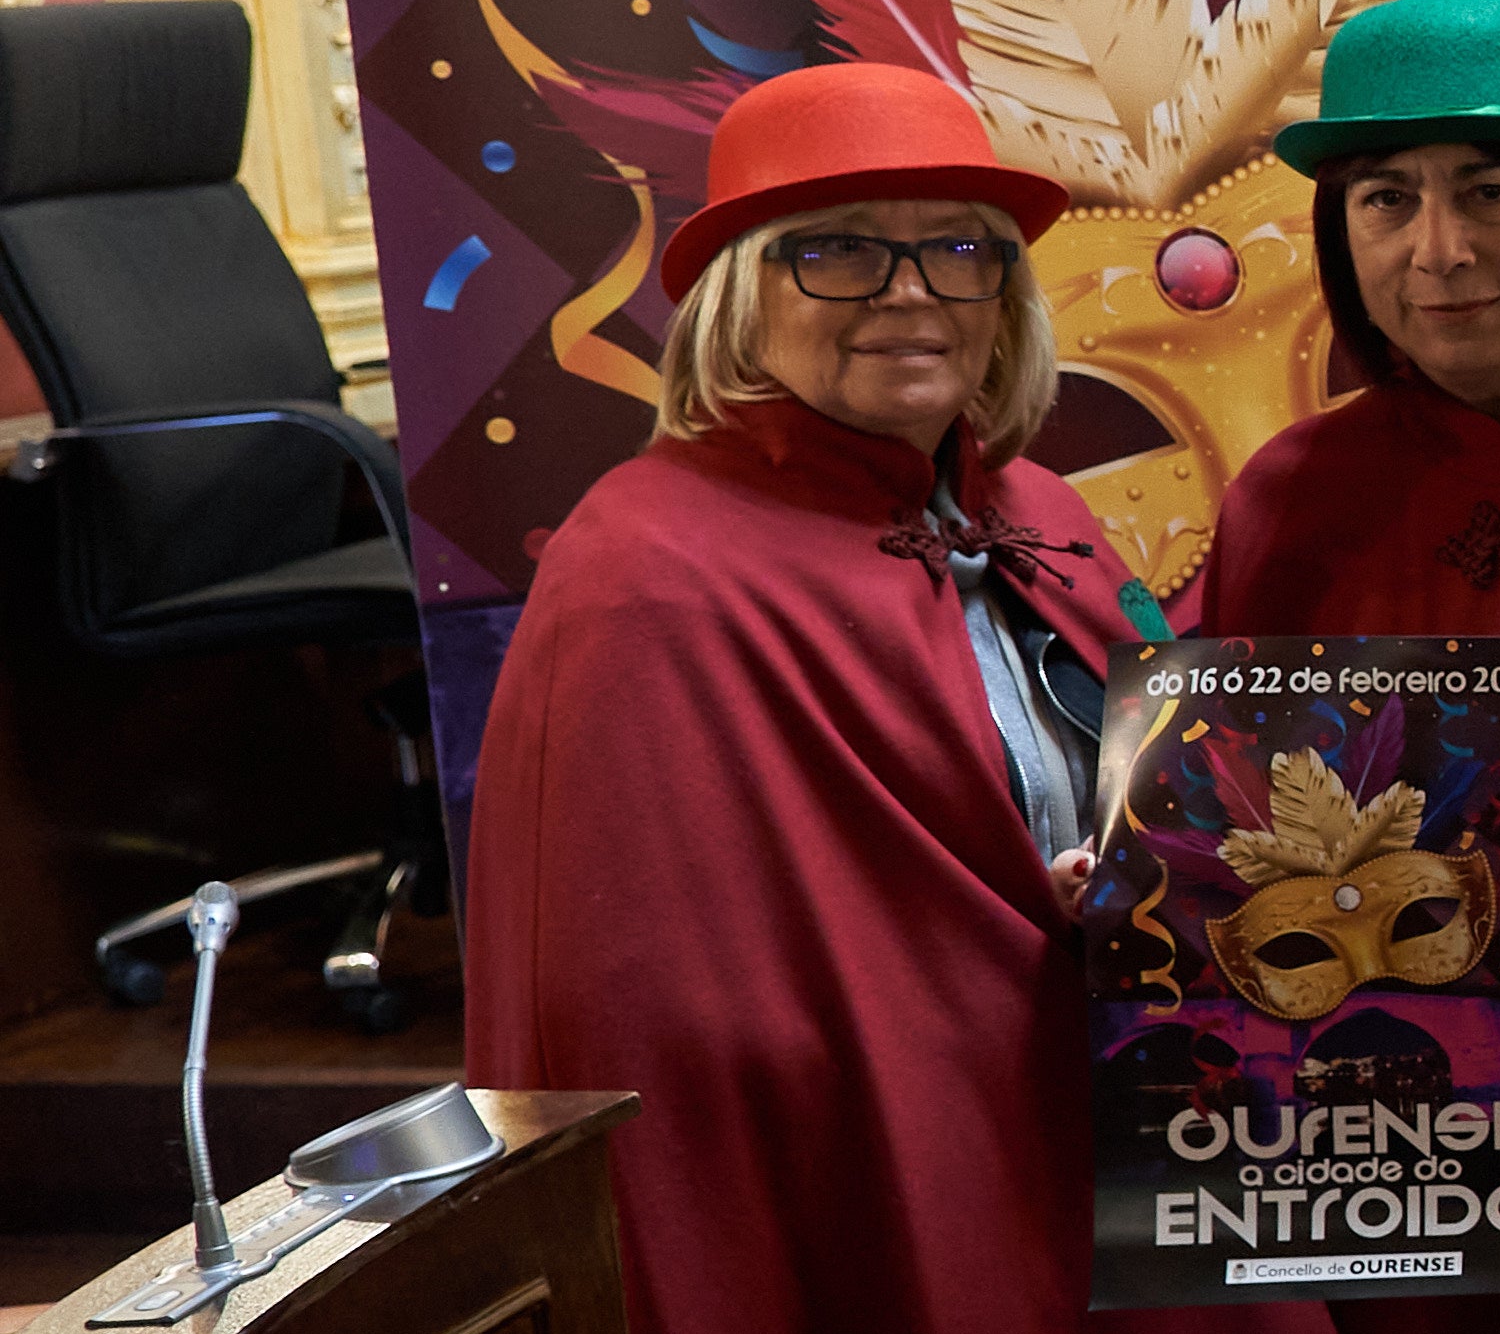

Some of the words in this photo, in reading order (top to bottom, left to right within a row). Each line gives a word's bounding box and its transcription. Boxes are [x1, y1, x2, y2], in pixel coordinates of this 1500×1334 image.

[1147, 669, 1183, 696] do
[1189, 668, 1217, 695] 16
[1248, 667, 1283, 694] 22
[1289, 667, 1332, 694] de
[1339, 666, 1467, 694] febreiro
[1239, 1165, 1263, 1186] a
[1273, 1157, 1404, 1185] cidade
[1414, 1155, 1462, 1181] do
[1255, 1262, 1322, 1278] Concello
[1327, 1262, 1346, 1275] de
[1350, 1256, 1455, 1275] OURENSE
